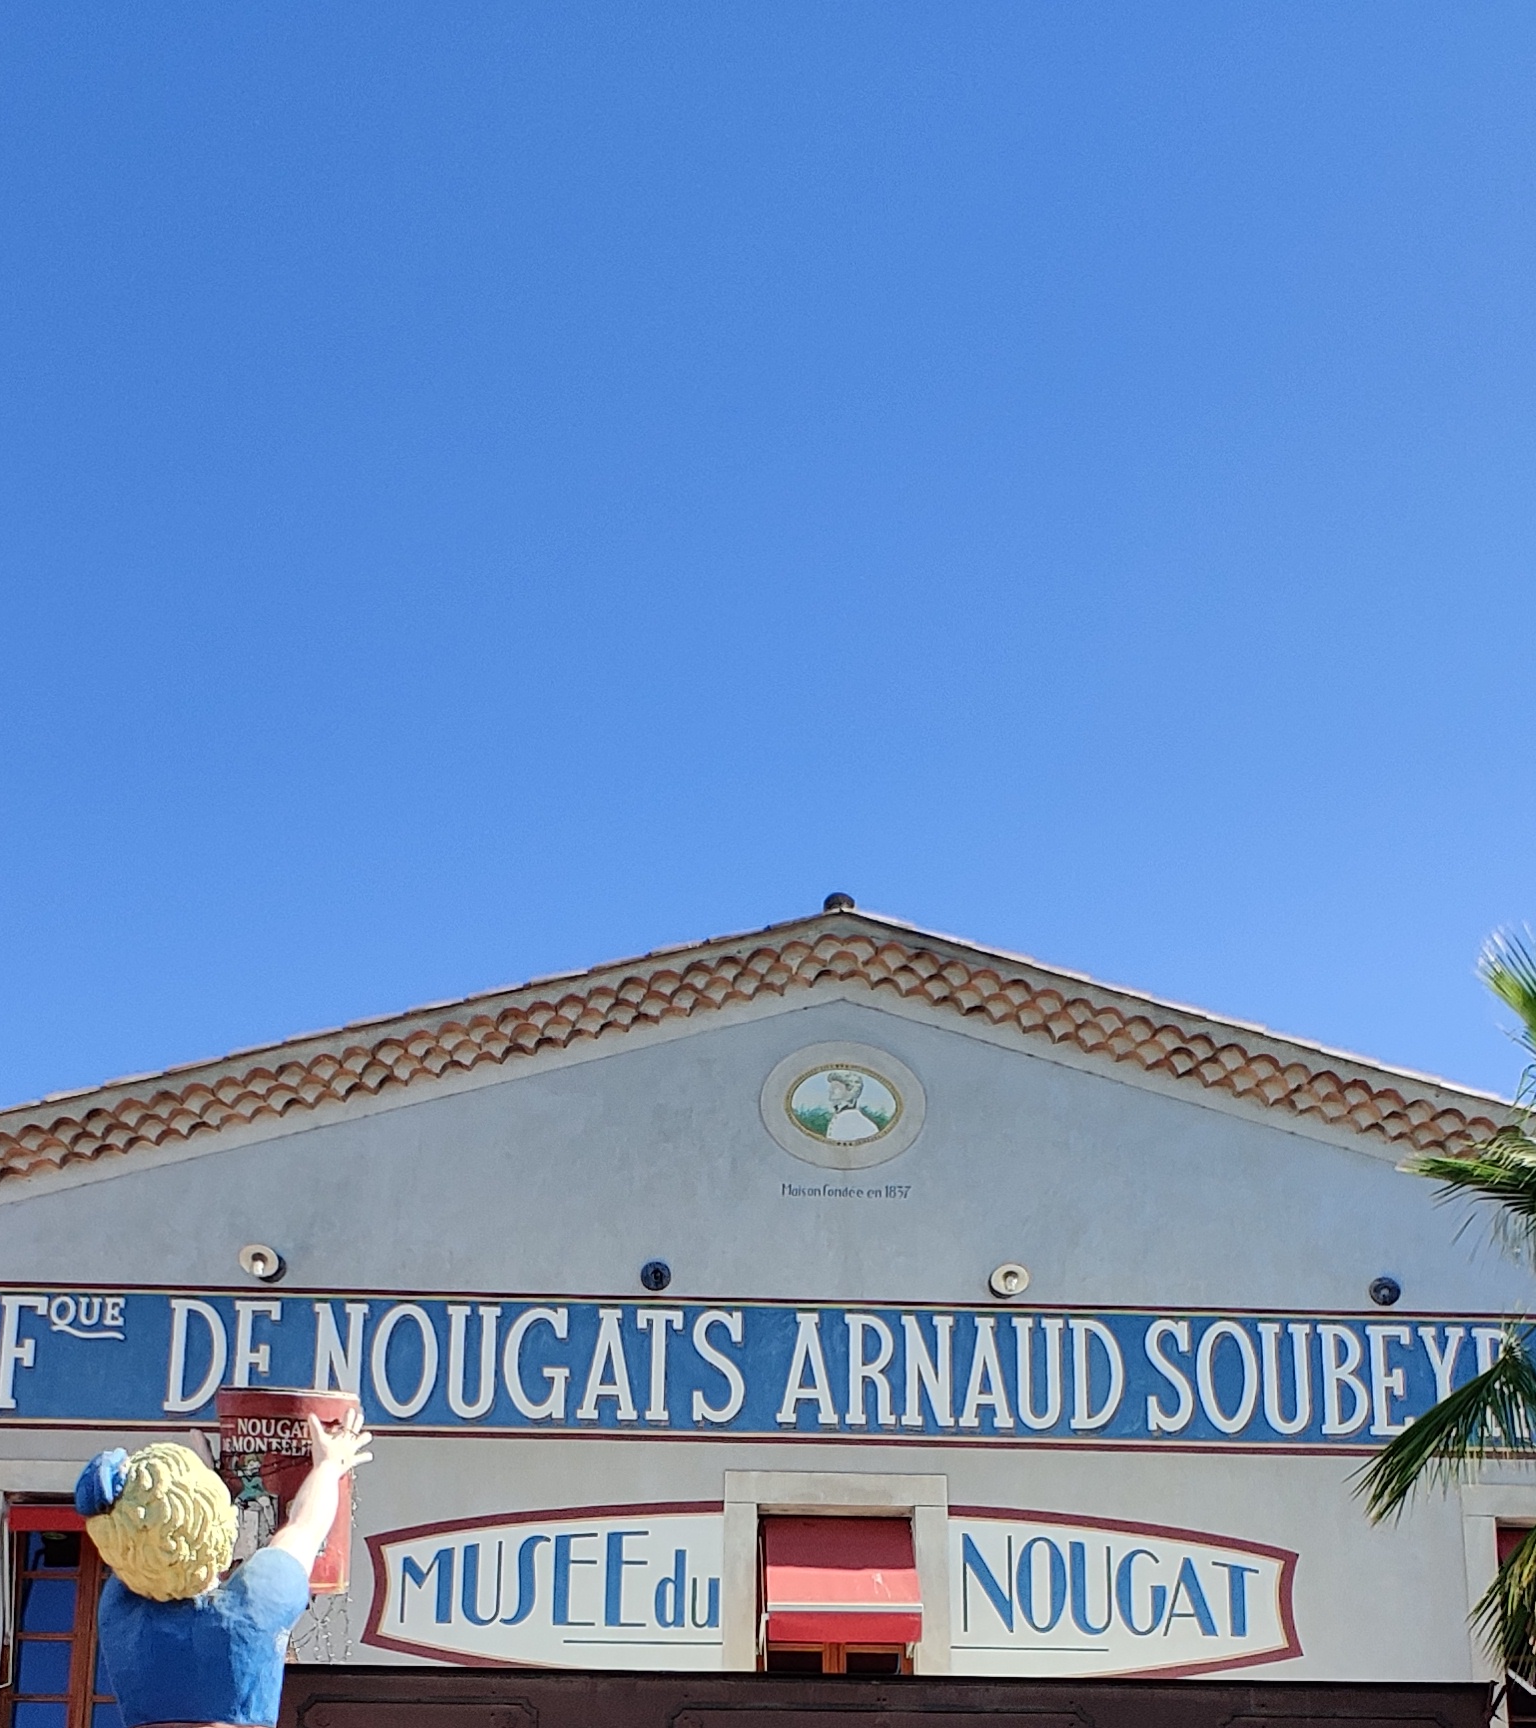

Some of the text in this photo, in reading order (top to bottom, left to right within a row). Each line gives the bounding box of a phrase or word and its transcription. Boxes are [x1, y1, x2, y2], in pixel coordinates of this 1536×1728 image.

[781, 1183, 820, 1197] Maison
[866, 1188, 882, 1198] en
[162, 1299, 282, 1414] DE
[313, 1303, 747, 1424] NOUGATS
[776, 1311, 1125, 1432] ARNAUD
[237, 1417, 310, 1440] NOUGAT
[398, 1529, 721, 1630] MUSEE du
[961, 1531, 1261, 1638] NOUGAT
